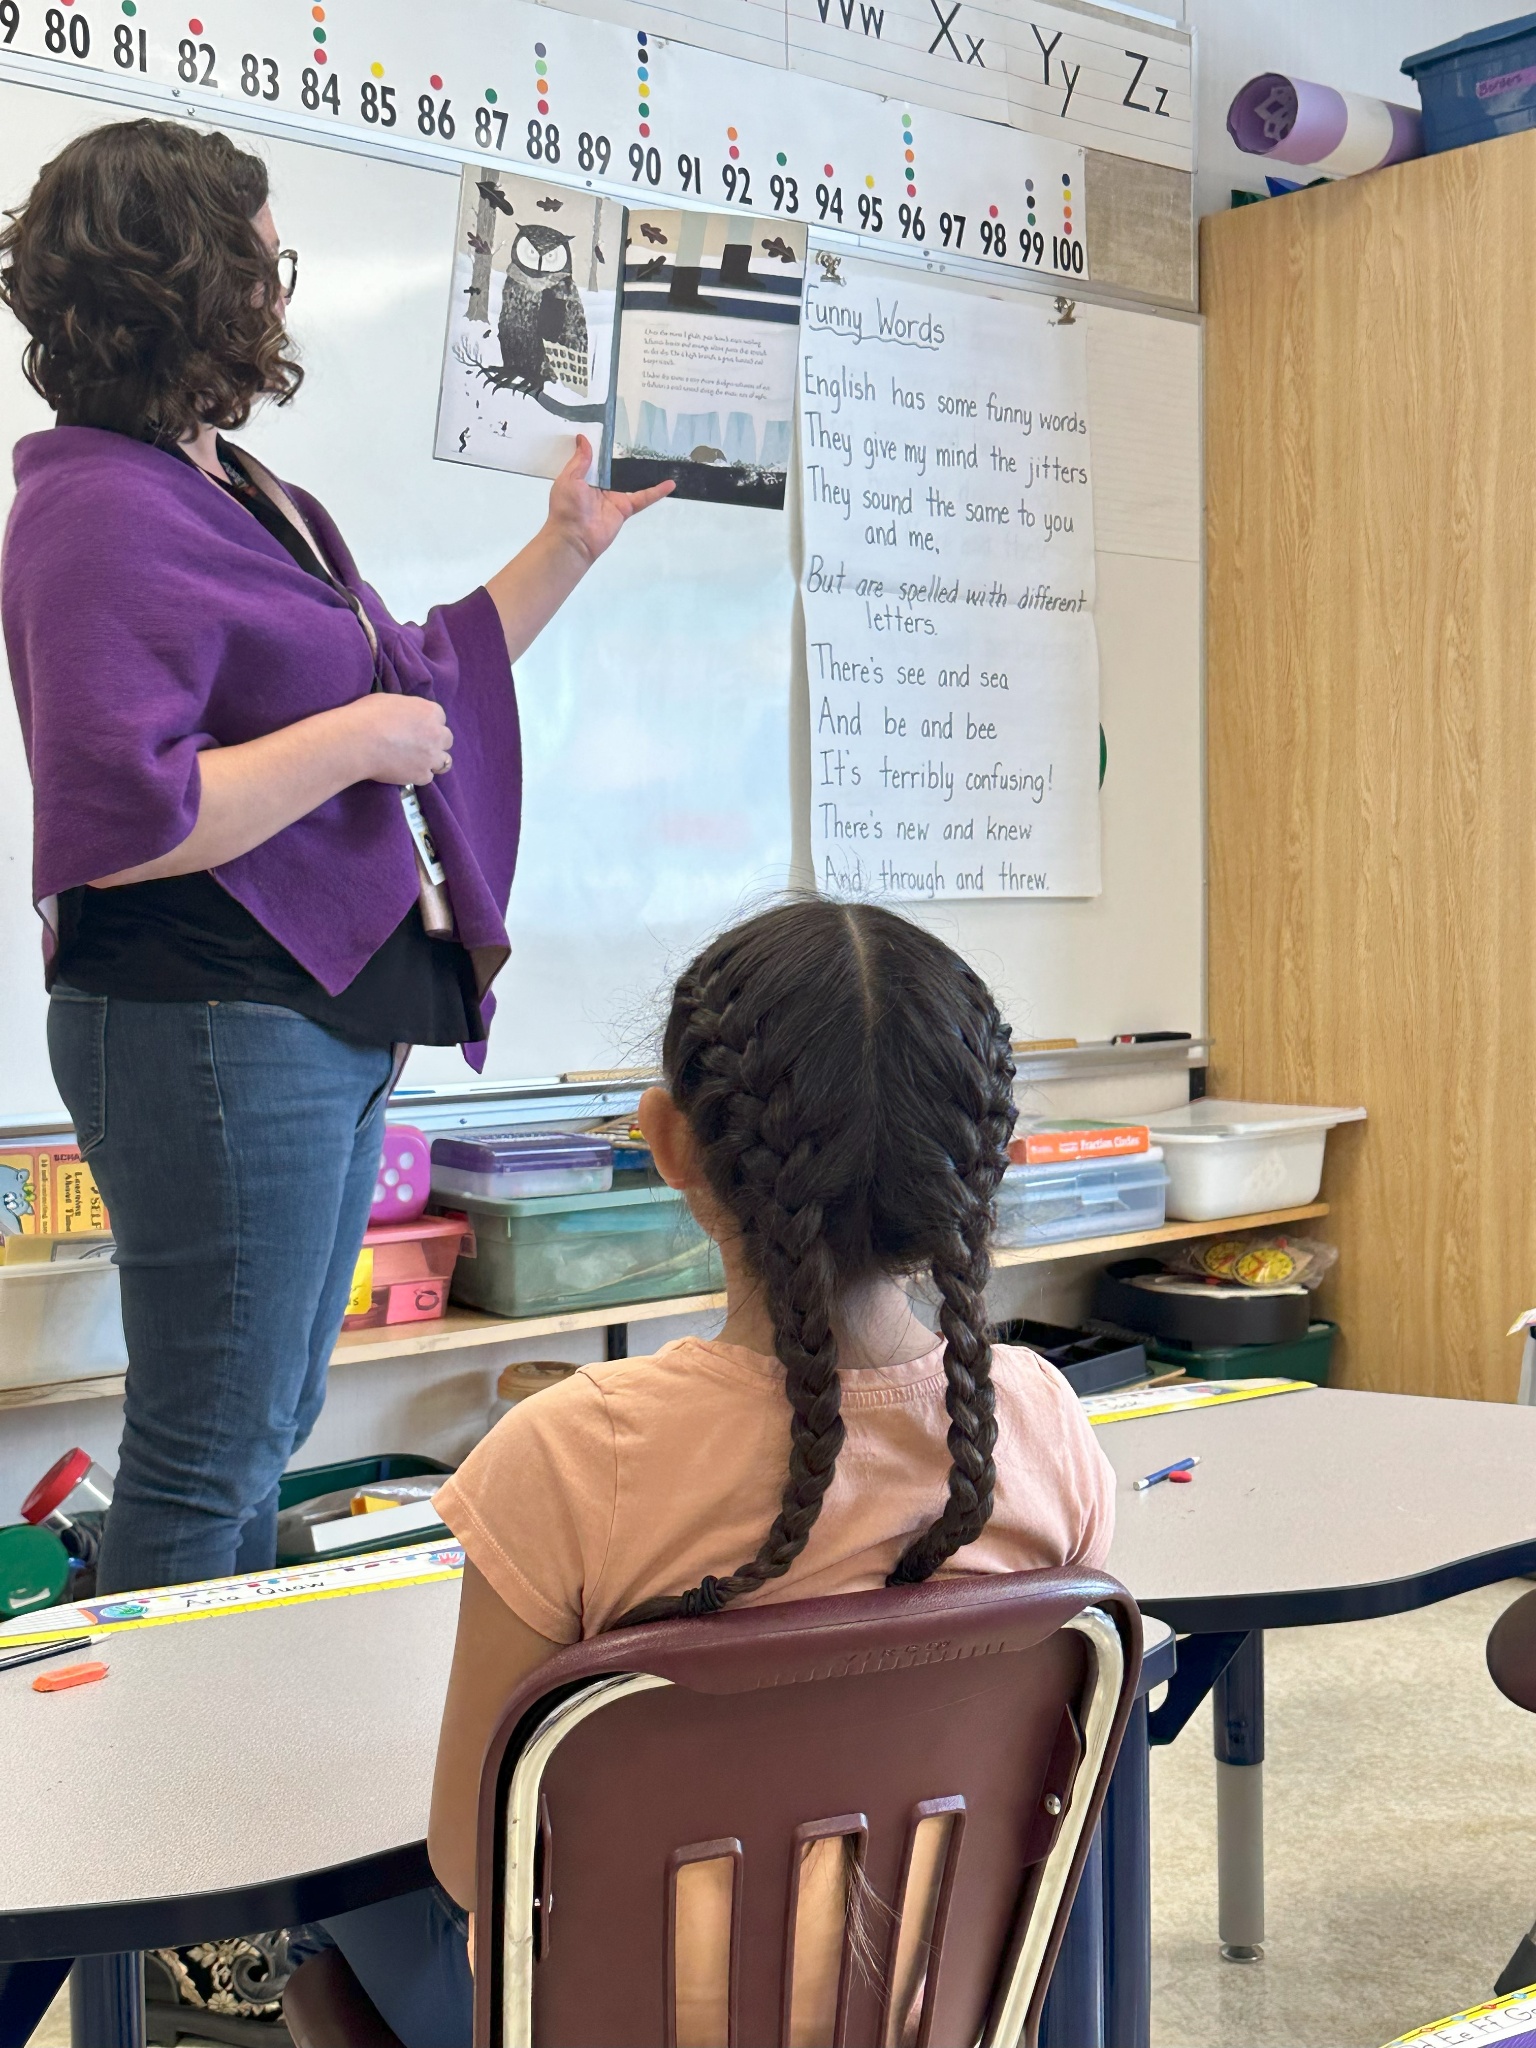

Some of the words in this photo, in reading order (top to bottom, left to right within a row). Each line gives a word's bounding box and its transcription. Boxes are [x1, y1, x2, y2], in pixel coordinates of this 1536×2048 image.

[928, 0, 986, 68] Xx
[1030, 23, 1081, 118] Yy
[1122, 50, 1171, 117] Zz
[44, 8, 91, 59] 80
[113, 24, 147, 73] 81
[177, 39, 219, 88] 82
[240, 53, 280, 101] 83
[301, 67, 341, 116] 84
[360, 82, 397, 128] 85
[417, 94, 456, 140] 86
[475, 106, 509, 151] 87
[526, 119, 561, 164] 88
[577, 131, 612, 175] 89
[628, 143, 662, 186] 90
[677, 153, 702, 195] 91
[722, 163, 753, 205] 92
[770, 174, 799, 214] 93
[815, 183, 844, 224] 94
[857, 193, 883, 233] 95
[898, 203, 926, 242] 96
[939, 212, 967, 249] 97
[980, 220, 1007, 258] 98
[1019, 229, 1045, 265] 99
[1053, 236, 1084, 274] 100
[805, 283, 862, 345] Funny
[877, 298, 945, 344] Words
[804, 356, 876, 413] English
[892, 376, 926, 410] has
[938, 394, 978, 418] some
[987, 392, 1032, 436] funny
[1040, 412, 1087, 435] words
[805, 411, 851, 466] They
[864, 431, 897, 469] give
[905, 442, 926, 476] my
[936, 442, 978, 469] mind
[990, 446, 1017, 472] the
[1025, 455, 1088, 488] jitters
[807, 465, 850, 520] They
[862, 488, 912, 516] sound
[926, 487, 956, 517] the
[966, 503, 1010, 525] same
[1018, 498, 1035, 528] to
[1044, 513, 1074, 542] you
[865, 520, 897, 547] and
[806, 555, 846, 595] But
[856, 578, 884, 598] are
[899, 575, 959, 610] spelled
[966, 581, 1007, 608] with
[1017, 584, 1087, 614] different
[865, 601, 938, 636] letters.
[811, 643, 884, 685] There's
[897, 664, 926, 686] see
[938, 664, 970, 687] and
[980, 671, 1010, 690] sea
[818, 696, 862, 736] And
[884, 706, 907, 737] be
[921, 712, 953, 739] and
[966, 712, 998, 740] bee
[820, 749, 862, 787] It's
[879, 755, 954, 802] terribly
[965, 762, 1053, 804] confusing!
[818, 803, 883, 840] There's
[897, 821, 930, 840] new
[943, 818, 974, 841] and
[986, 816, 1033, 841] knew
[825, 855, 862, 892] And
[879, 859, 945, 898] through
[956, 864, 984, 891] and
[998, 861, 1050, 891] threw.
